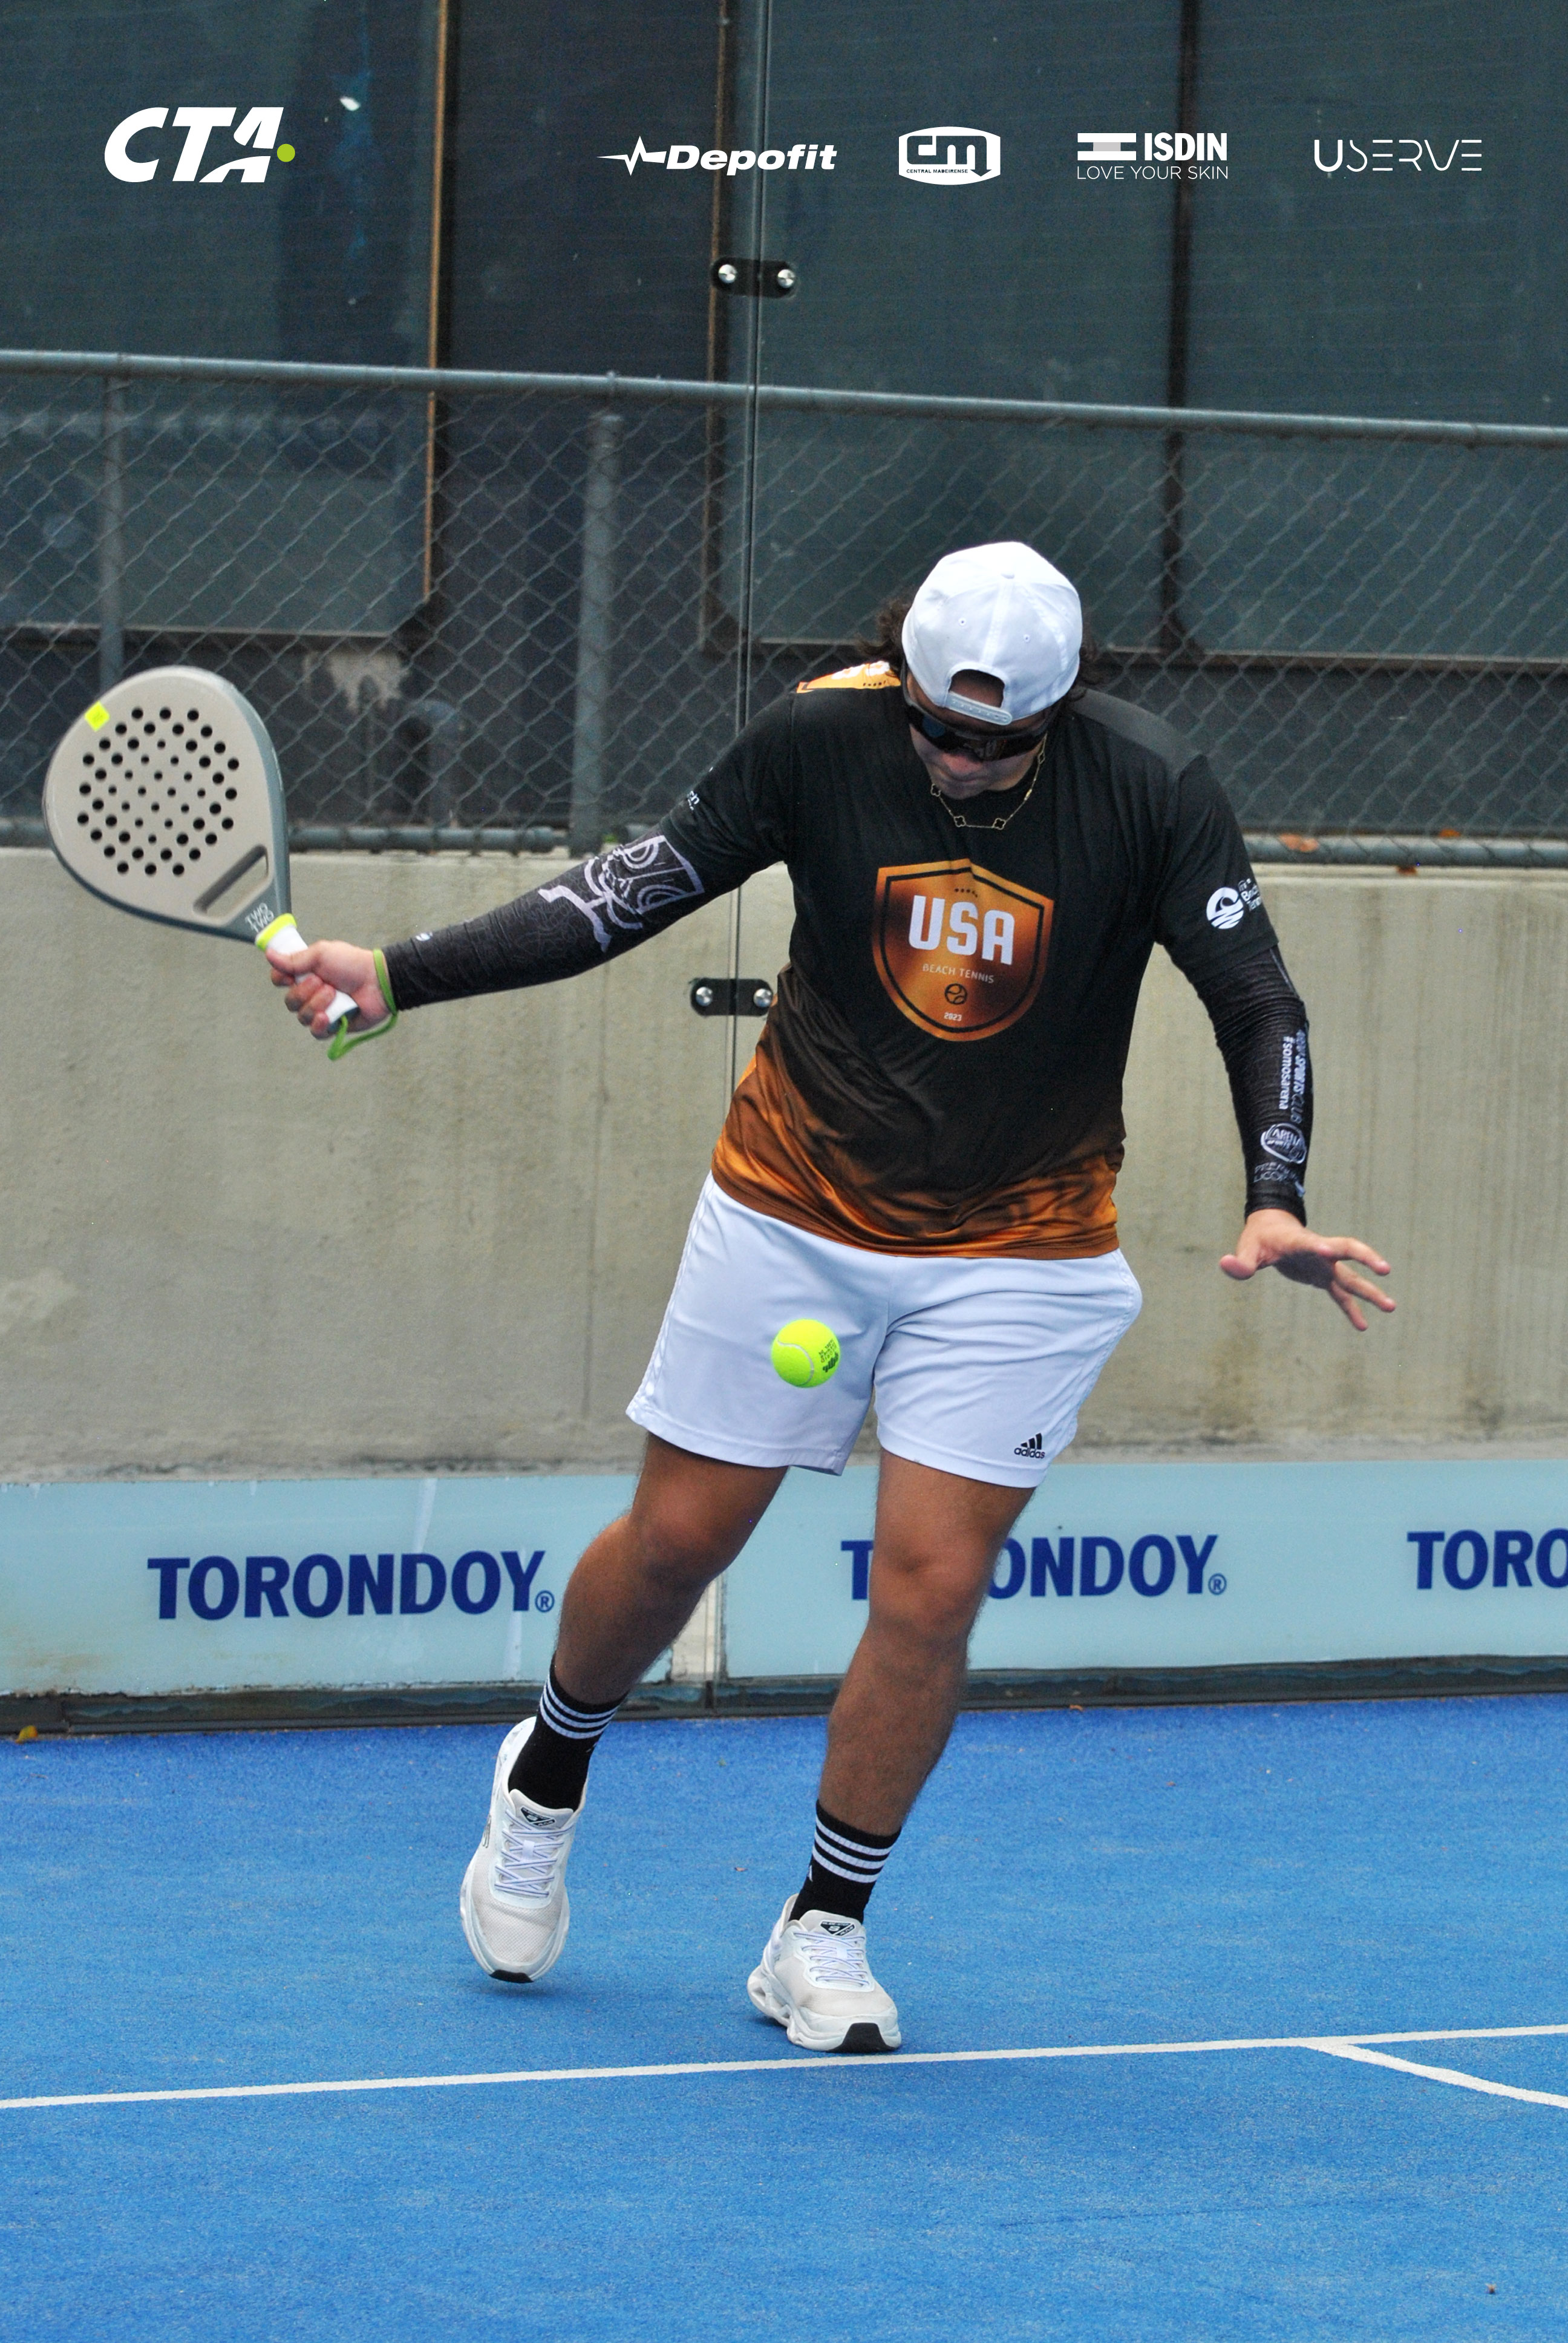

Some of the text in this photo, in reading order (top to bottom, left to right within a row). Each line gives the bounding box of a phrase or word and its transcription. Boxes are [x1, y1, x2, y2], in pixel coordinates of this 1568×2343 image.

[909, 894, 1014, 965] USA
[923, 963, 995, 984] BEACH TENNIS
[1014, 1447, 1045, 1459] adidas
[1406, 1527, 1568, 1590] TORO
